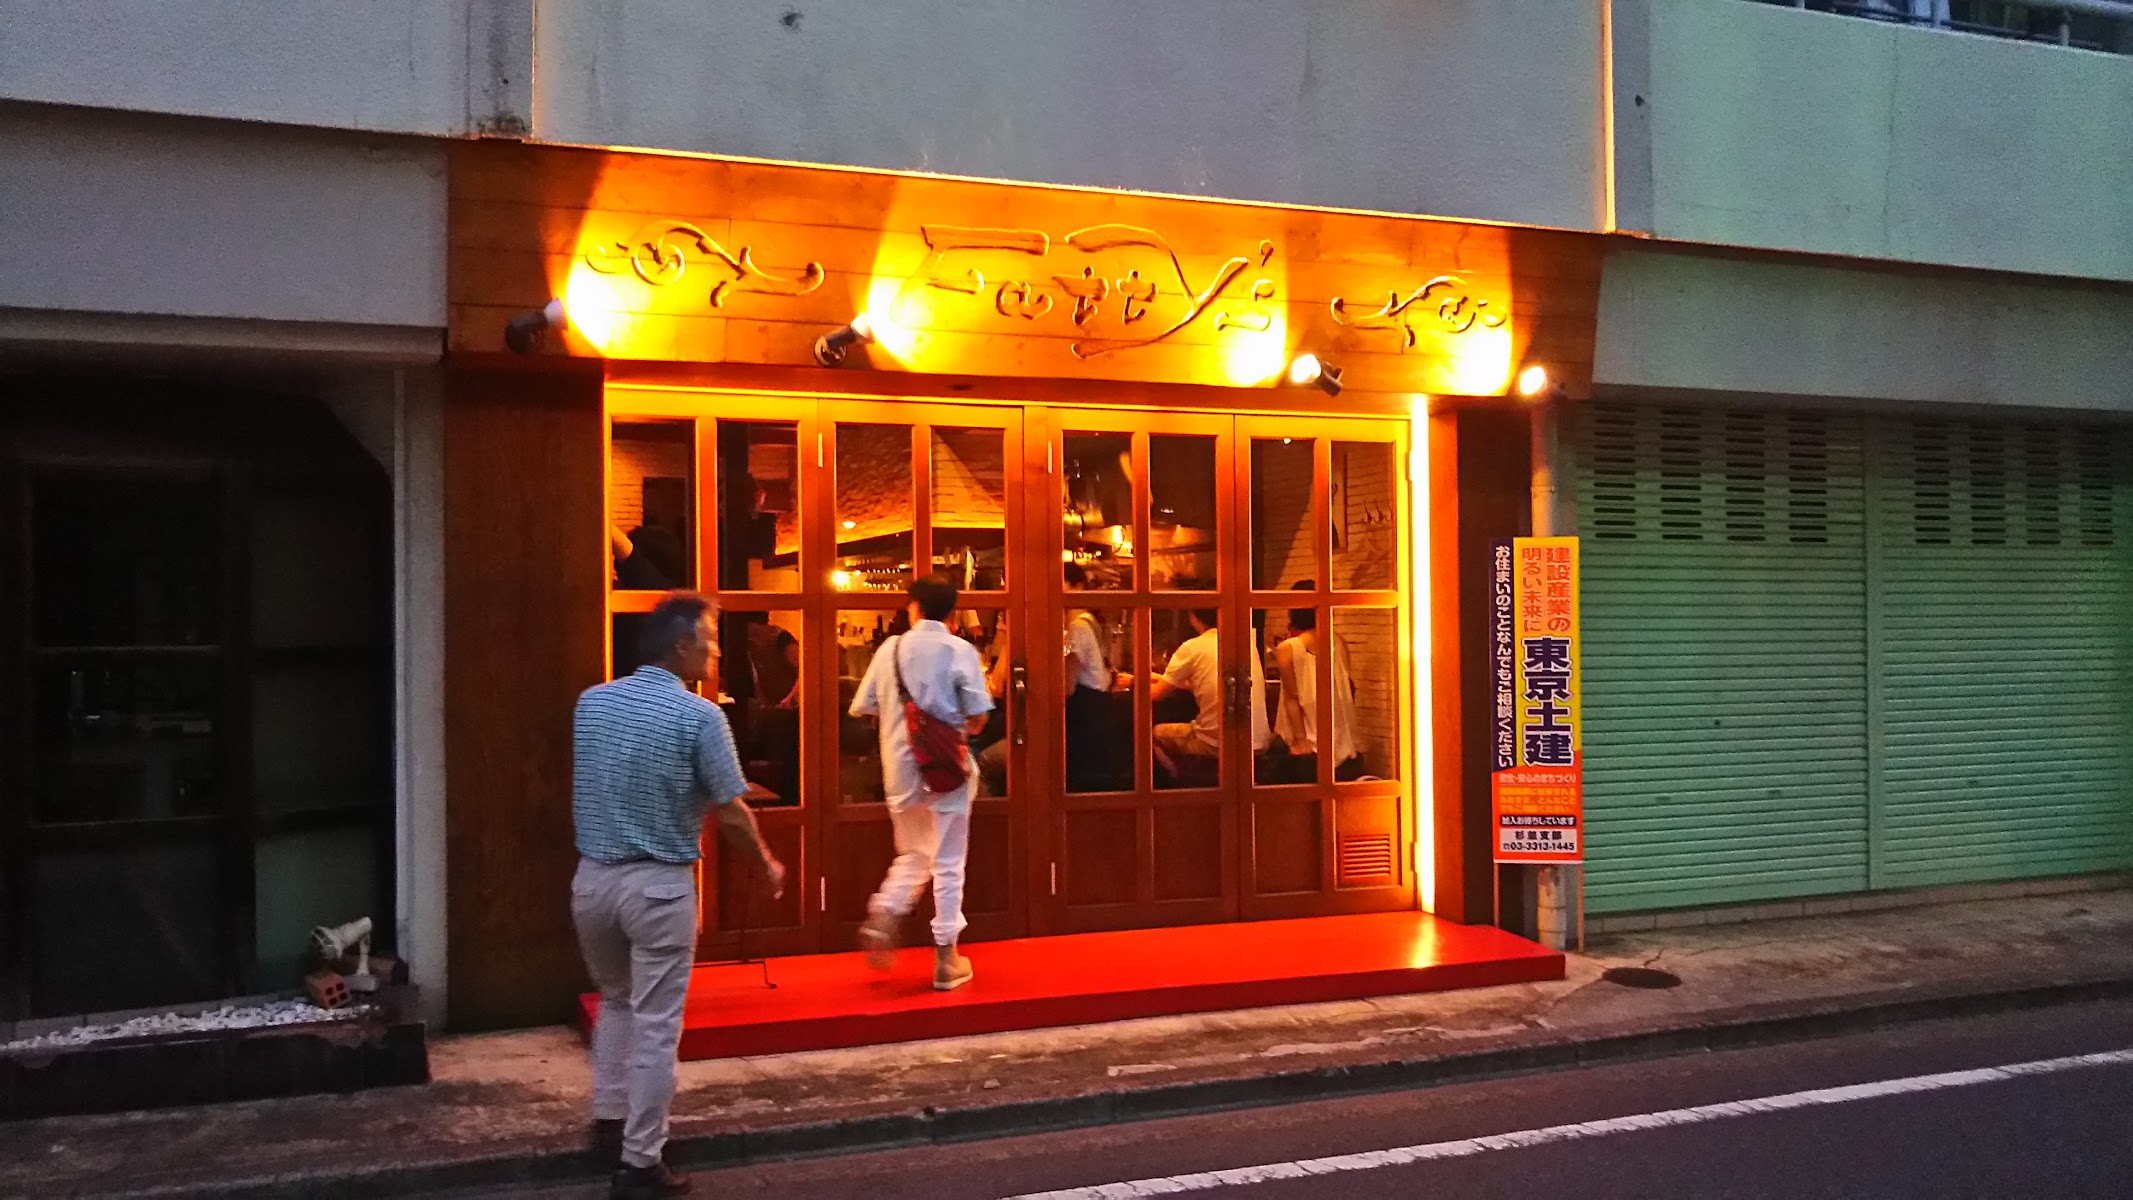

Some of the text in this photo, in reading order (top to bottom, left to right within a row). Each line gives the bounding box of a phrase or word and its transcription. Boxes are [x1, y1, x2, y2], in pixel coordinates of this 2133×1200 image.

[1522, 547, 1542, 632] 明るい未来に
[1546, 547, 1571, 631] 建設産業の
[1495, 545, 1513, 767] お住まいのことなんでもご相談ください
[1522, 636, 1574, 767] 東京土建
